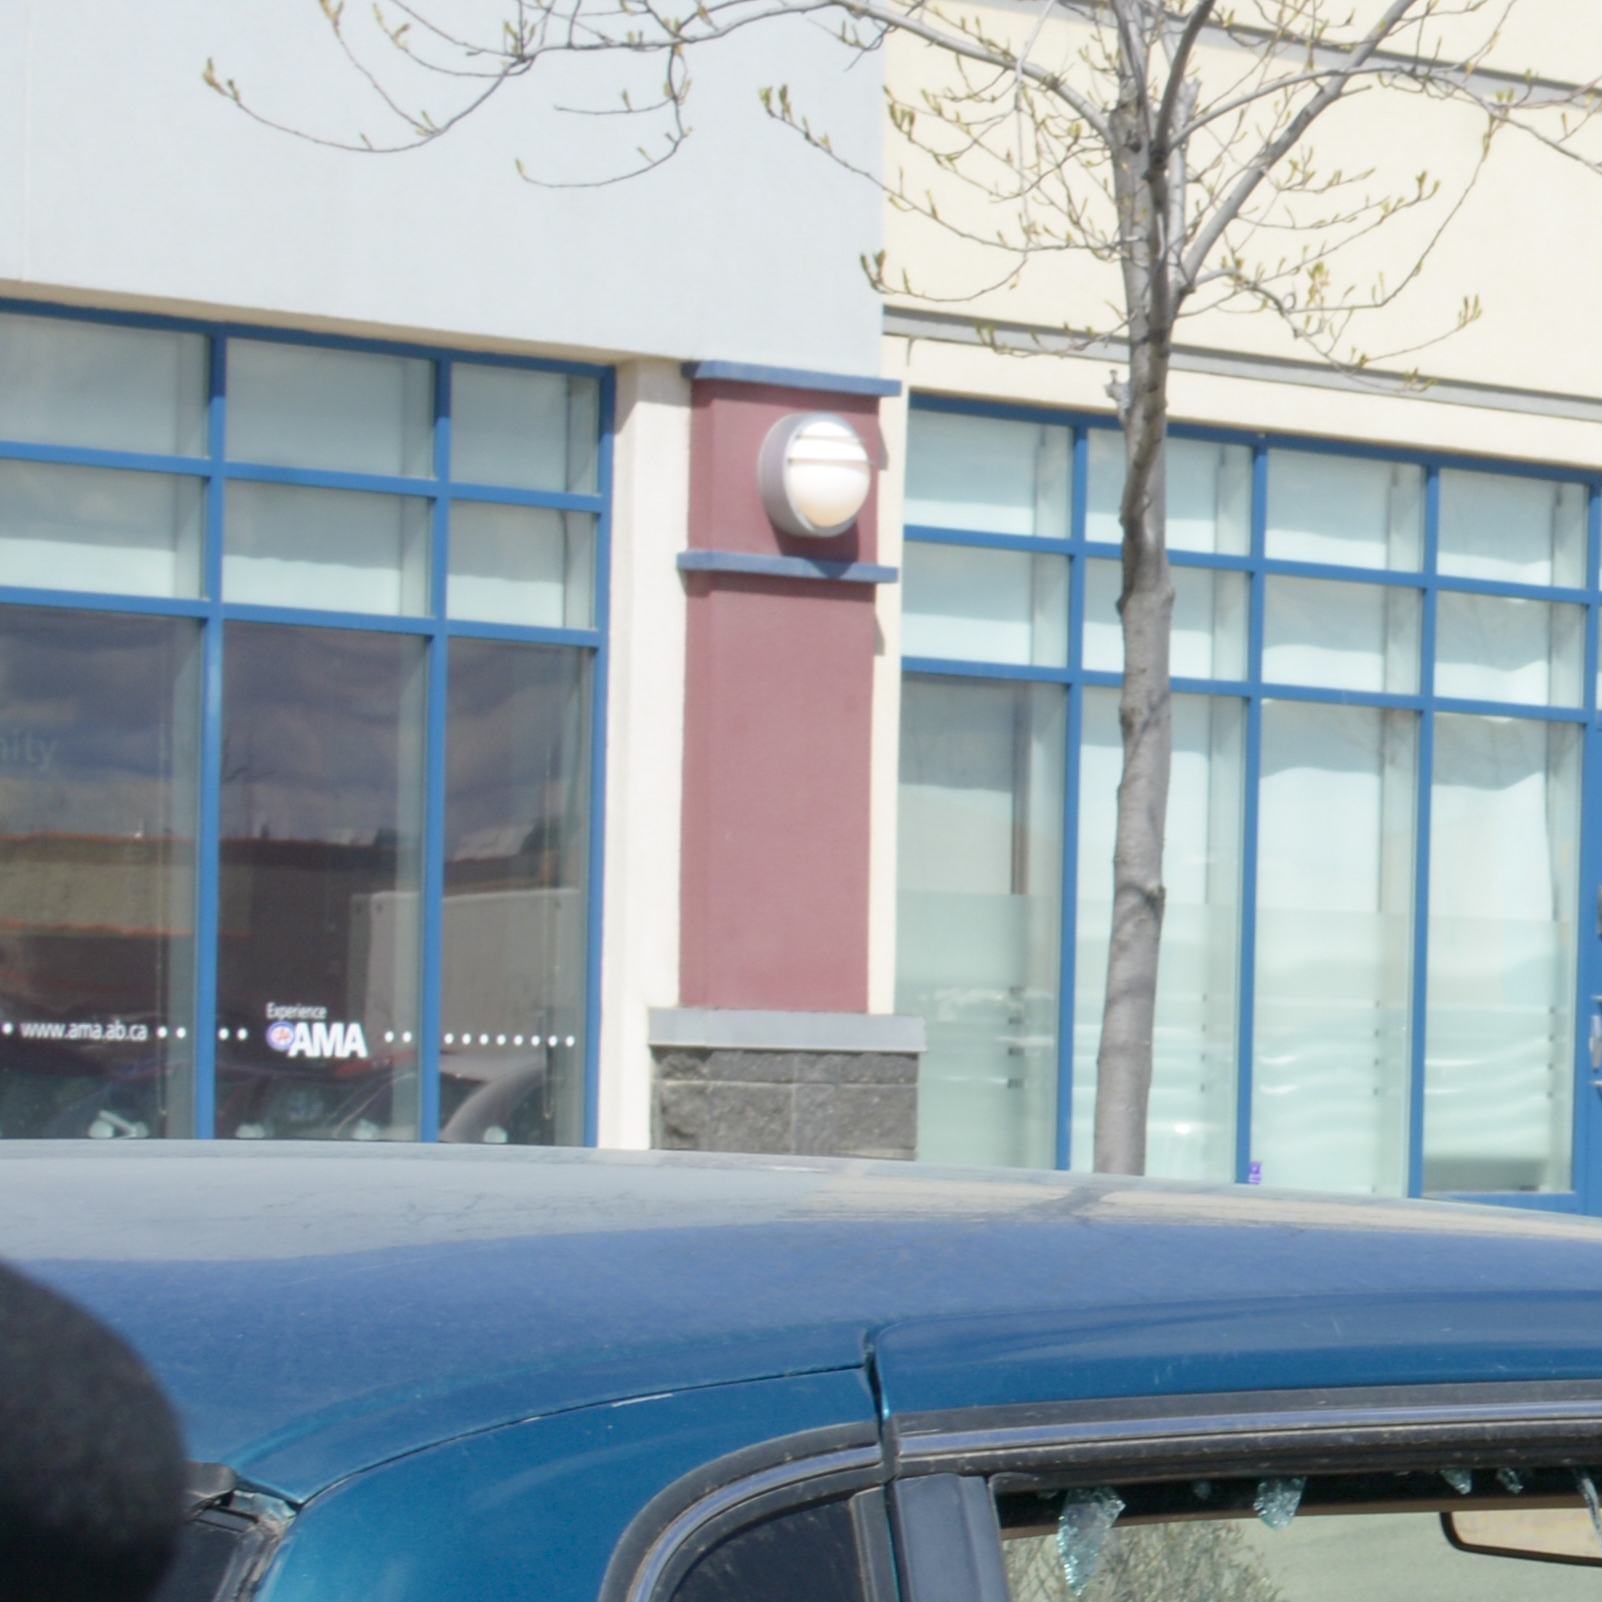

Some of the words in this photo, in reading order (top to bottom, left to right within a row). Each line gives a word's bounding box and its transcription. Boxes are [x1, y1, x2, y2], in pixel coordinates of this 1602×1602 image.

[266, 1001, 327, 1020] Experience
[20, 1019, 149, 1042] www.ama.ab.ca
[287, 1021, 368, 1058] AMA
